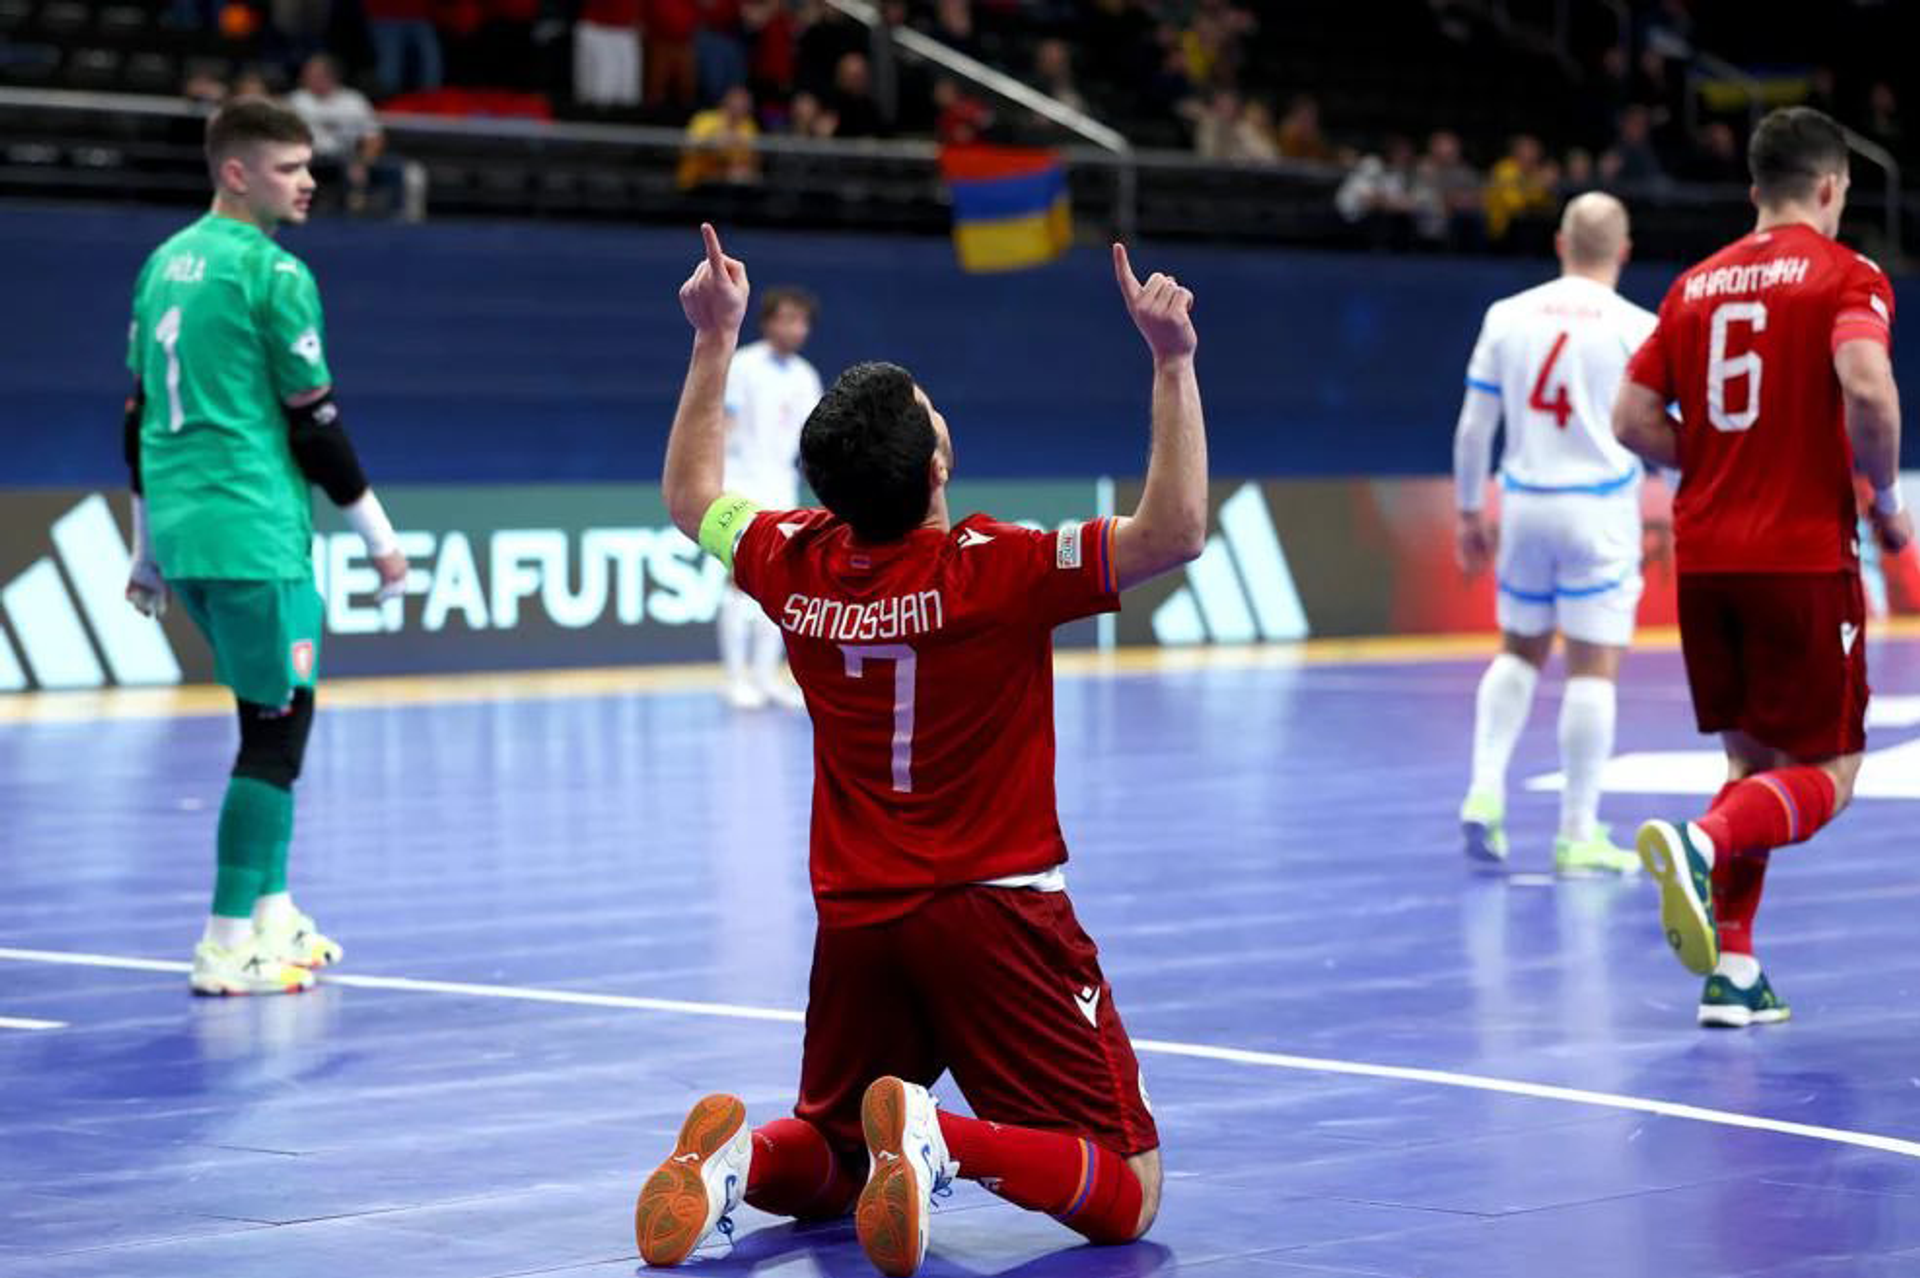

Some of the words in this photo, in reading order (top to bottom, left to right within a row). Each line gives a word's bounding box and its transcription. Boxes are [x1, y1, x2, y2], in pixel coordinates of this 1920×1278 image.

[156, 306, 184, 433] 1
[1529, 331, 1572, 430] 4
[1707, 301, 1767, 433] 6
[782, 589, 943, 640] SANOSYAN
[839, 644, 917, 793] 7
